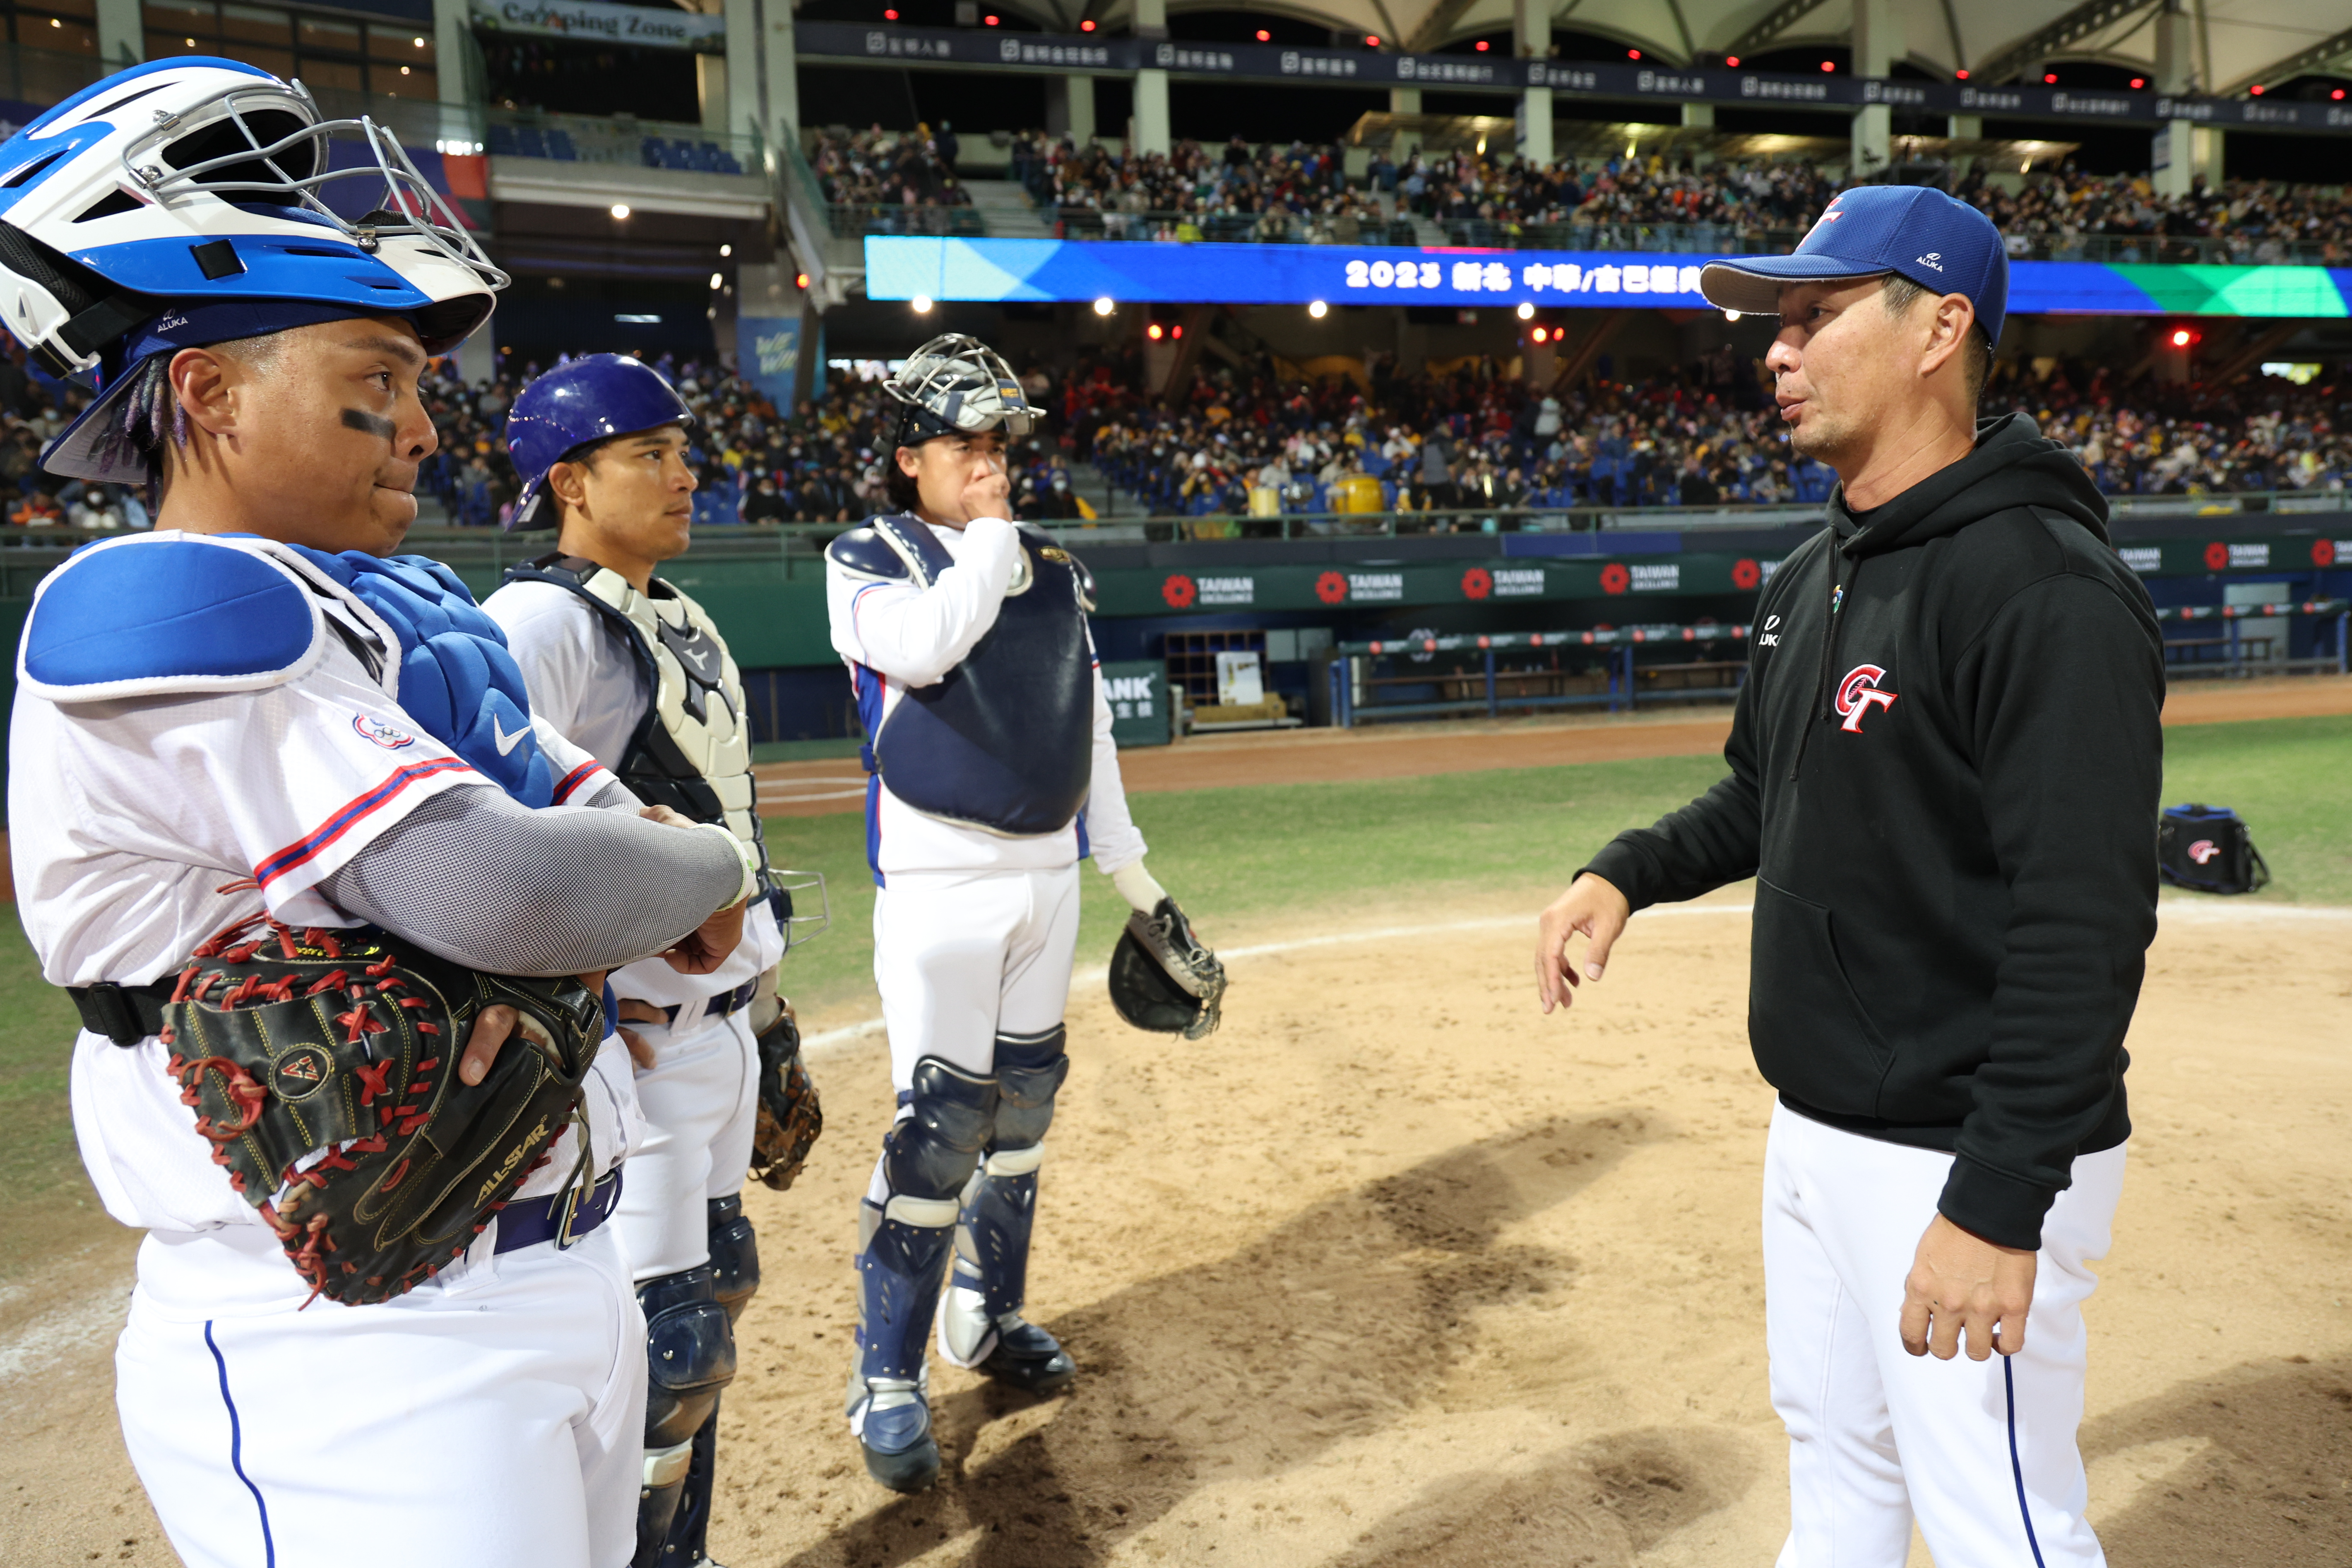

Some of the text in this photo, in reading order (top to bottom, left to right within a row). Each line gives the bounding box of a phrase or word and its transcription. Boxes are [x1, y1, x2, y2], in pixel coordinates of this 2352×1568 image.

[625, 14, 687, 38] Zone
[1916, 256, 1943, 272] ALUKA
[1345, 260, 1441, 289] 2023
[157, 317, 188, 333] ALUKA
[1493, 569, 1544, 584] TAIWAN
[1630, 564, 1679, 579] TAIWAN
[1197, 577, 1253, 591] TAIWAN
[1349, 574, 1402, 588] TAIWAN
[474, 1123, 550, 1209] ALL-STAR
